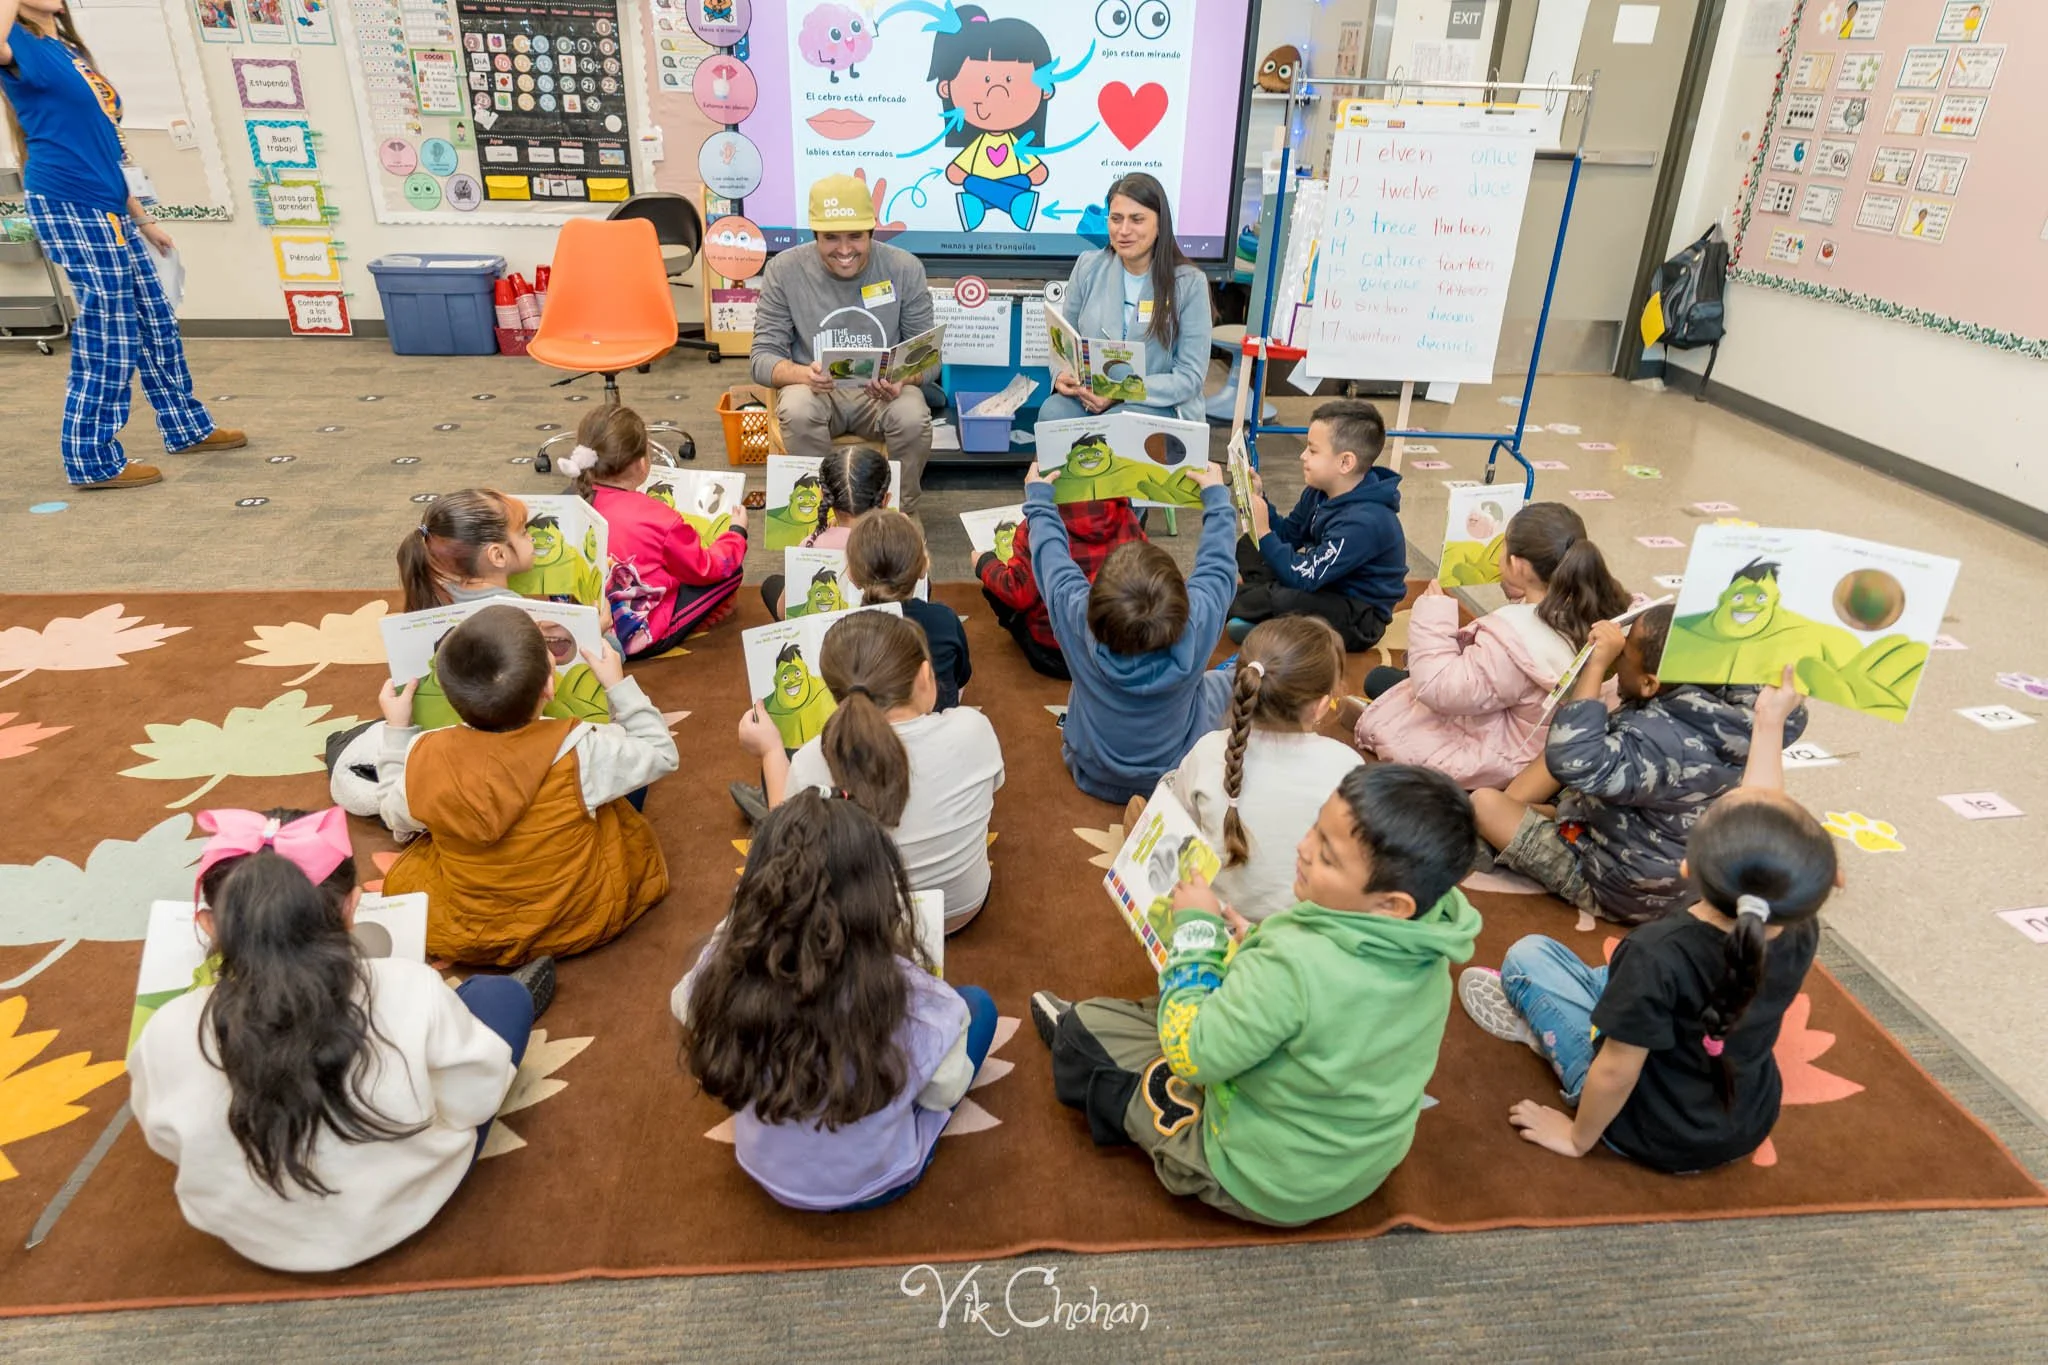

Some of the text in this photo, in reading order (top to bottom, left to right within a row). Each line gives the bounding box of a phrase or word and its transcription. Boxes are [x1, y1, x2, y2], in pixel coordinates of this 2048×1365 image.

[1452, 12, 1481, 25] EXIT
[1102, 49, 1181, 59] ojos estan mirando
[806, 92, 907, 103] El cebro está enfocado
[267, 145, 298, 154] trabajo!
[806, 148, 894, 158] labios estan cerrados
[1345, 138, 1518, 167] 11 elven once
[1101, 158, 1108, 167] el
[1339, 176, 1361, 200] 12
[1378, 176, 1439, 200] twelve
[824, 198, 838, 208] DO
[825, 208, 856, 218] GOOD.
[1334, 208, 1354, 227] 13
[1372, 212, 1417, 236] trece
[968, 243, 974, 252] y
[976, 242, 992, 251] pies
[996, 242, 1036, 252] tranquilos
[1330, 237, 1347, 257] 14
[1324, 288, 1342, 312] 16
[833, 328, 848, 336] THE
[1321, 320, 1341, 343] 17
[834, 334, 872, 343] LEADERS
